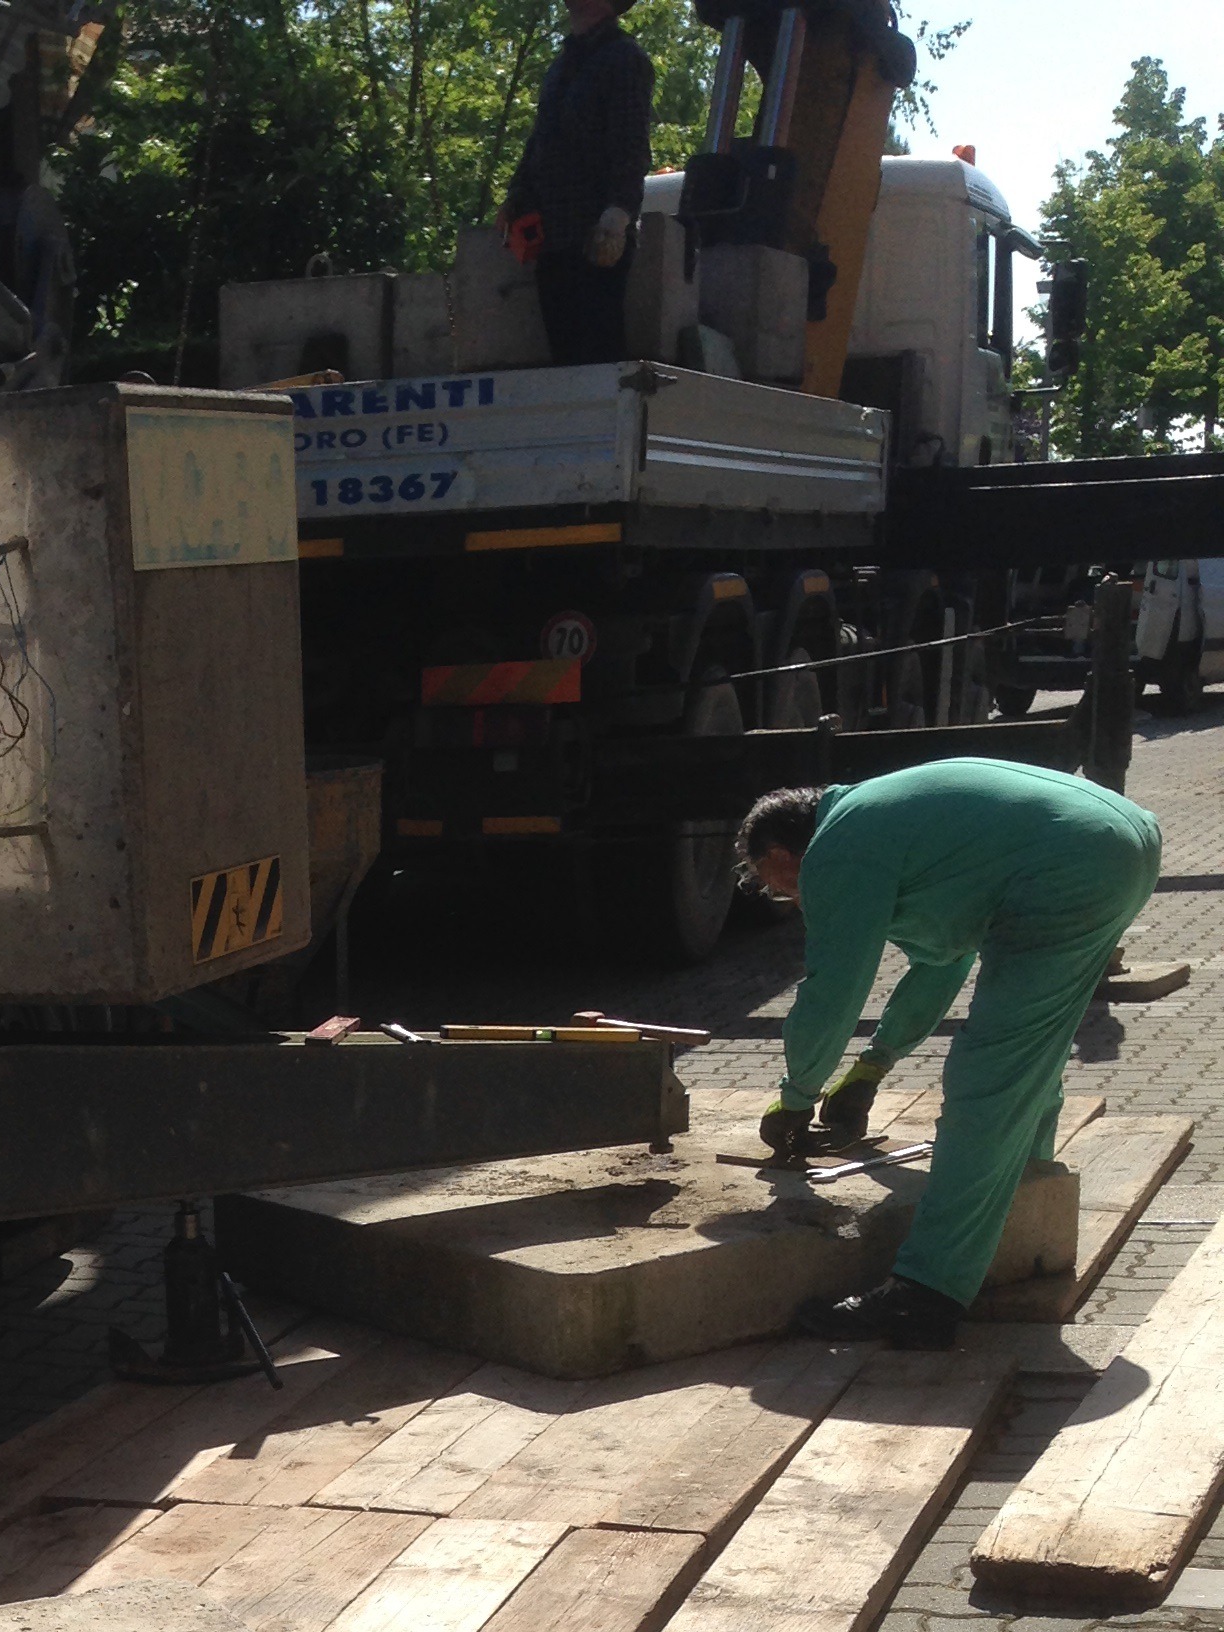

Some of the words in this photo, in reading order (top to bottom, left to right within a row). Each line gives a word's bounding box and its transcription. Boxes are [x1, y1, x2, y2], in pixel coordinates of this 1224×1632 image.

[382, 422, 448, 450] (FE)
[311, 470, 458, 507] 18367
[557, 626, 584, 655] 70
